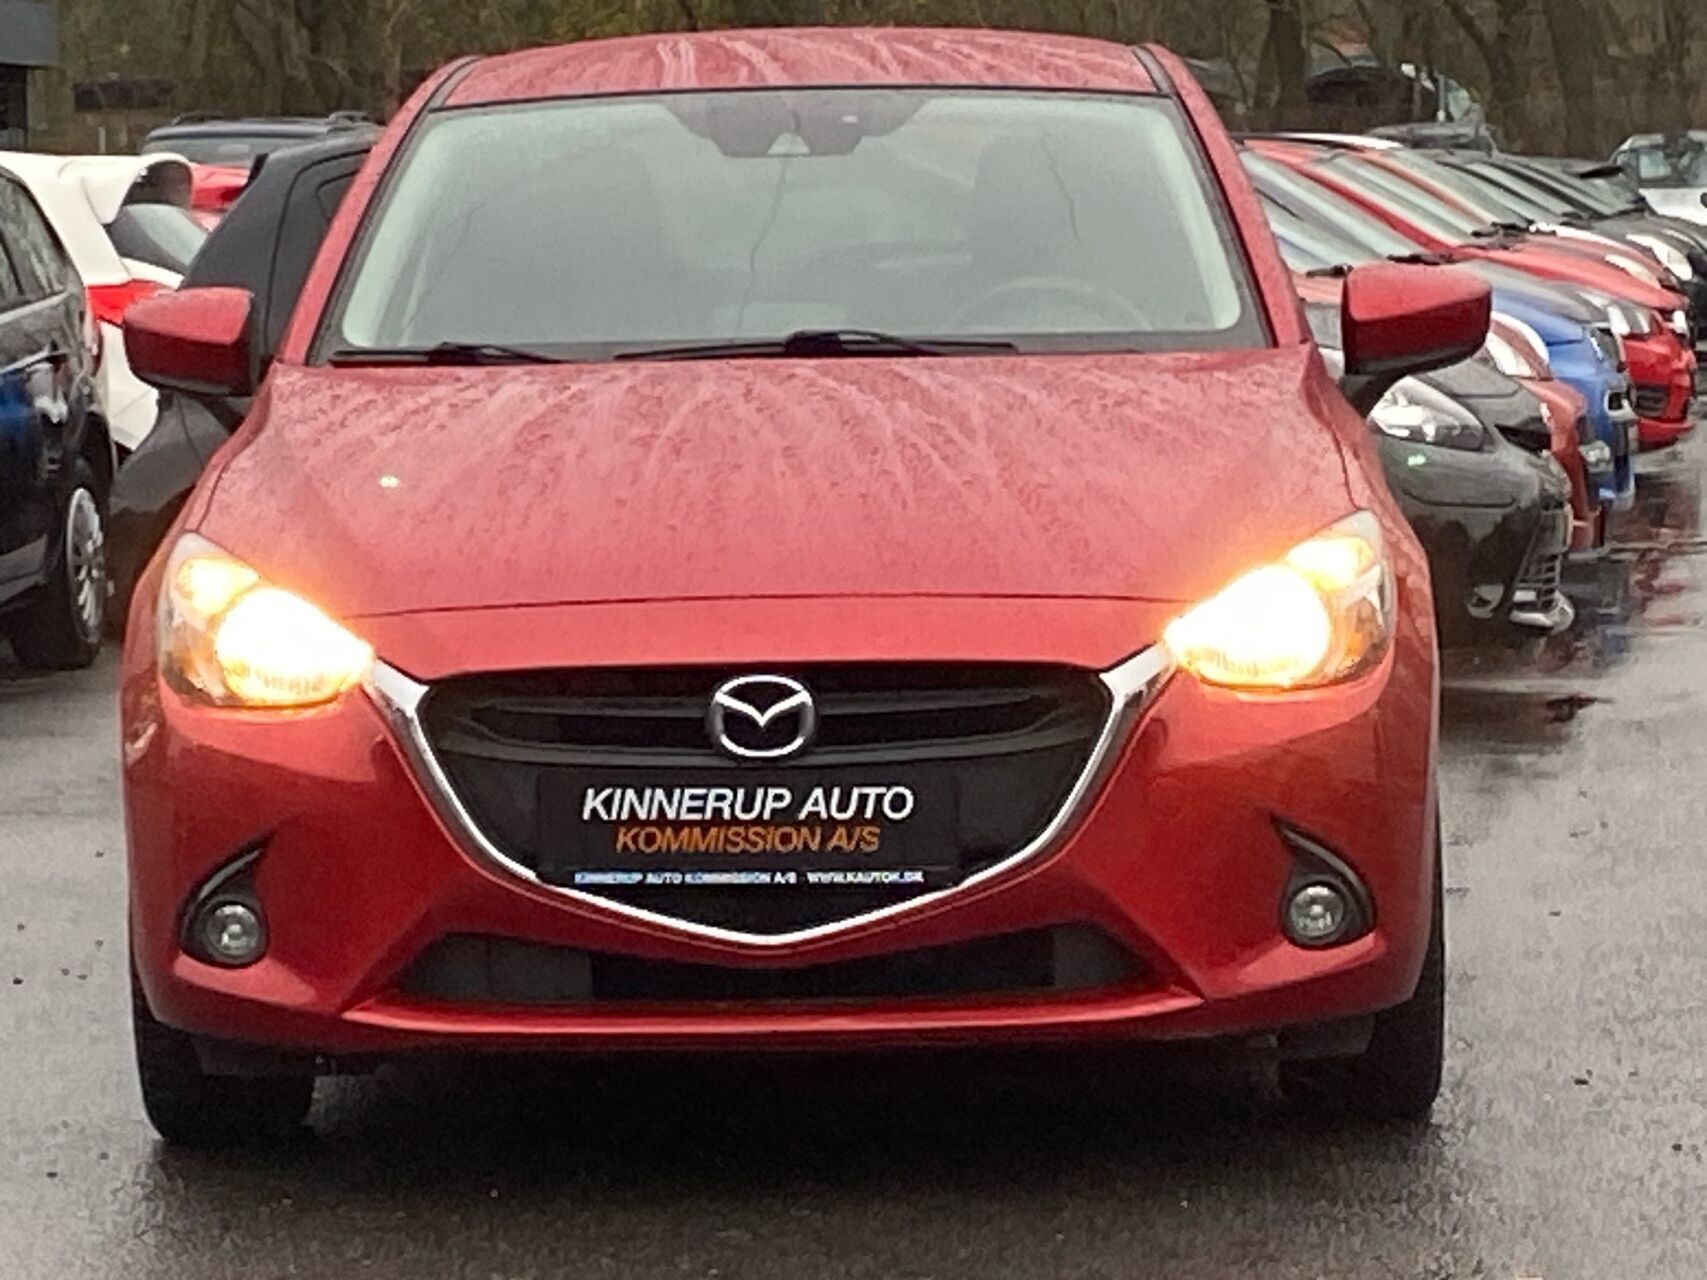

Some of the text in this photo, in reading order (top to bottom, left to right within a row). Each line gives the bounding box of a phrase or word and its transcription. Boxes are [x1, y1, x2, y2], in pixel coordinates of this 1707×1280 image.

[582, 786, 914, 821] KINNERUP AUTO
[616, 825, 881, 853] KOMMISSION A/S
[645, 871, 683, 884] AUTO
